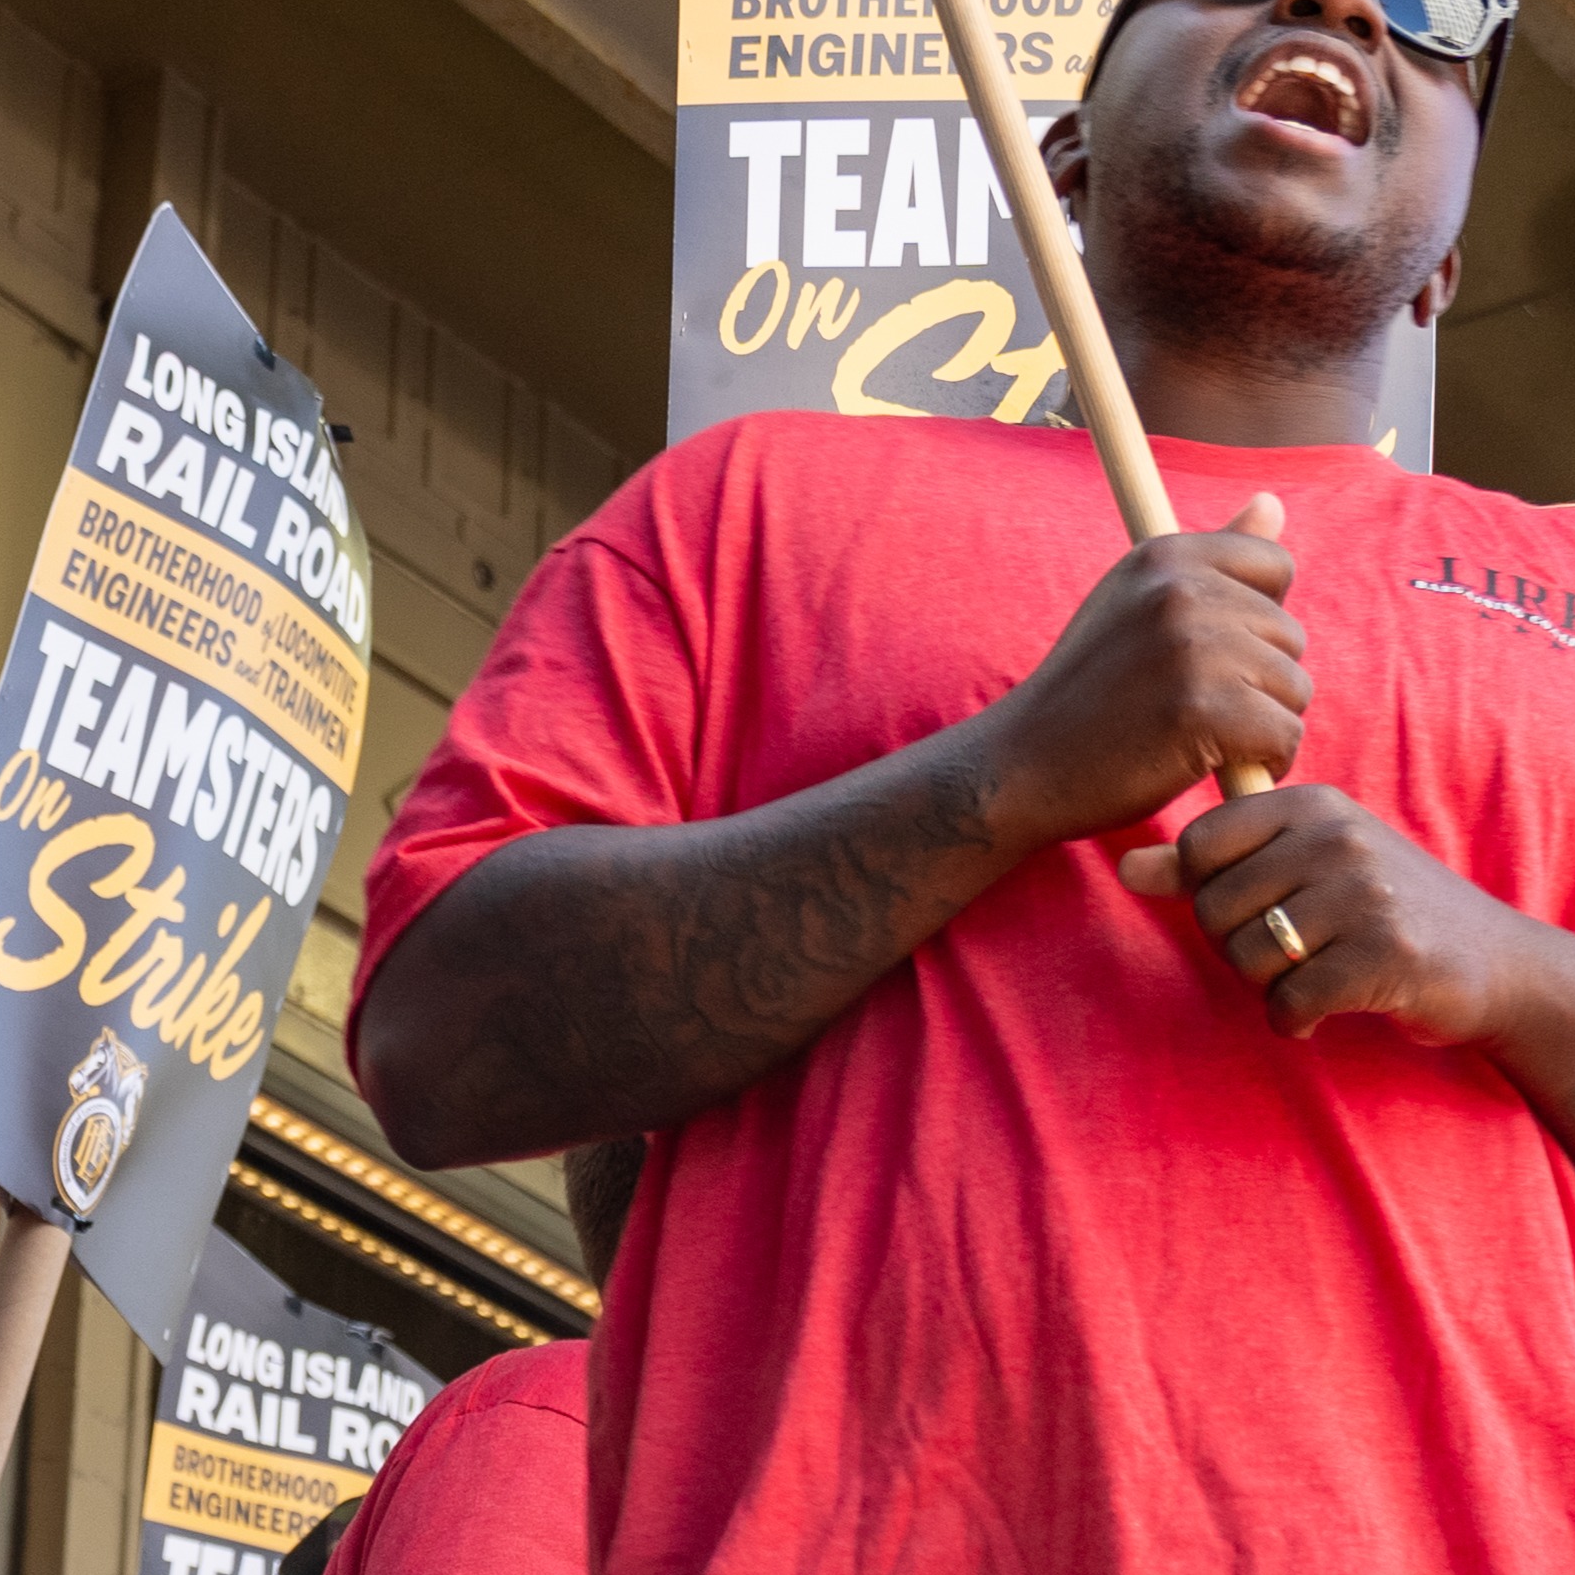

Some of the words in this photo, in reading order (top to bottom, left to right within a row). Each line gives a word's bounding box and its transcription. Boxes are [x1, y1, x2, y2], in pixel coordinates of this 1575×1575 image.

[720, 259, 859, 355] On
[125, 333, 246, 453] LONG
[96, 400, 257, 550] RAIL
[264, 495, 367, 645] ROAD
[60, 548, 236, 669] ENGINEERS
[264, 659, 349, 761] TRAINMEN
[78, 499, 263, 628] BROTHERHOOD
[275, 611, 358, 714] LOCOMOTIVE
[19, 620, 332, 907] TEAMSTERS
[176, 1365, 317, 1455] RAIL
[187, 1313, 285, 1389] LONG
[290, 1348, 426, 1427] ISLAND
[173, 1445, 337, 1508] BROTHERHOOD
